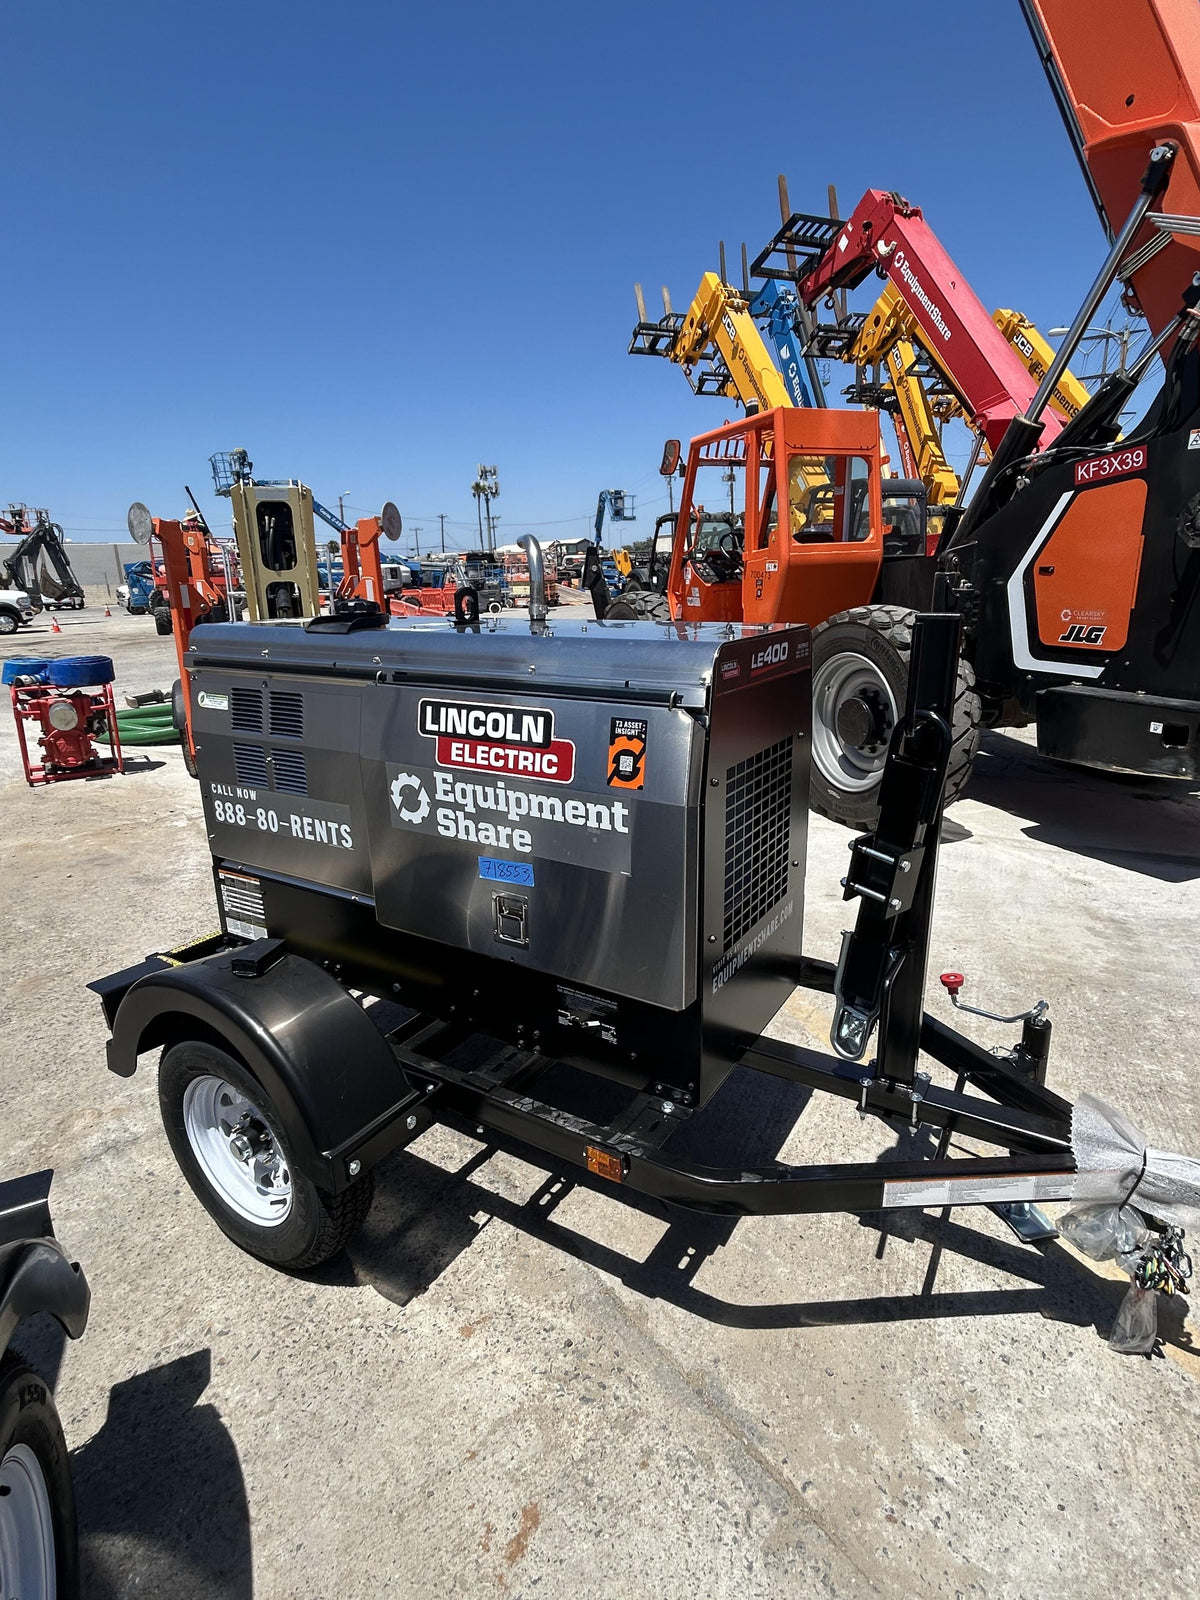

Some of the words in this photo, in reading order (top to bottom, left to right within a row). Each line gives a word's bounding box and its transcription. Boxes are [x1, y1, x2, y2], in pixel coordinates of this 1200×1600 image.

[900, 259, 952, 341] EquipmentShare
[722, 313, 736, 341] JCB
[891, 346, 903, 370] JCB
[1013, 332, 1033, 357] JCB
[1077, 450, 1144, 480] KF3X39
[751, 570, 771, 580] 700473
[1058, 624, 1107, 645] JLG
[752, 641, 788, 669] LE400
[425, 705, 544, 744] LINCOLN
[616, 720, 623, 728] T3
[624, 721, 642, 729] ASSET
[451, 742, 558, 775] ELECTRIC
[211, 783, 233, 797] CALL
[237, 787, 257, 801] NOW
[433, 771, 629, 833] Equipment
[214, 800, 353, 848] 888-80-RENTS
[437, 808, 532, 853] Share
[483, 861, 532, 882] 718553
[712, 899, 794, 994] EQUIPMENTSHARE.COM
